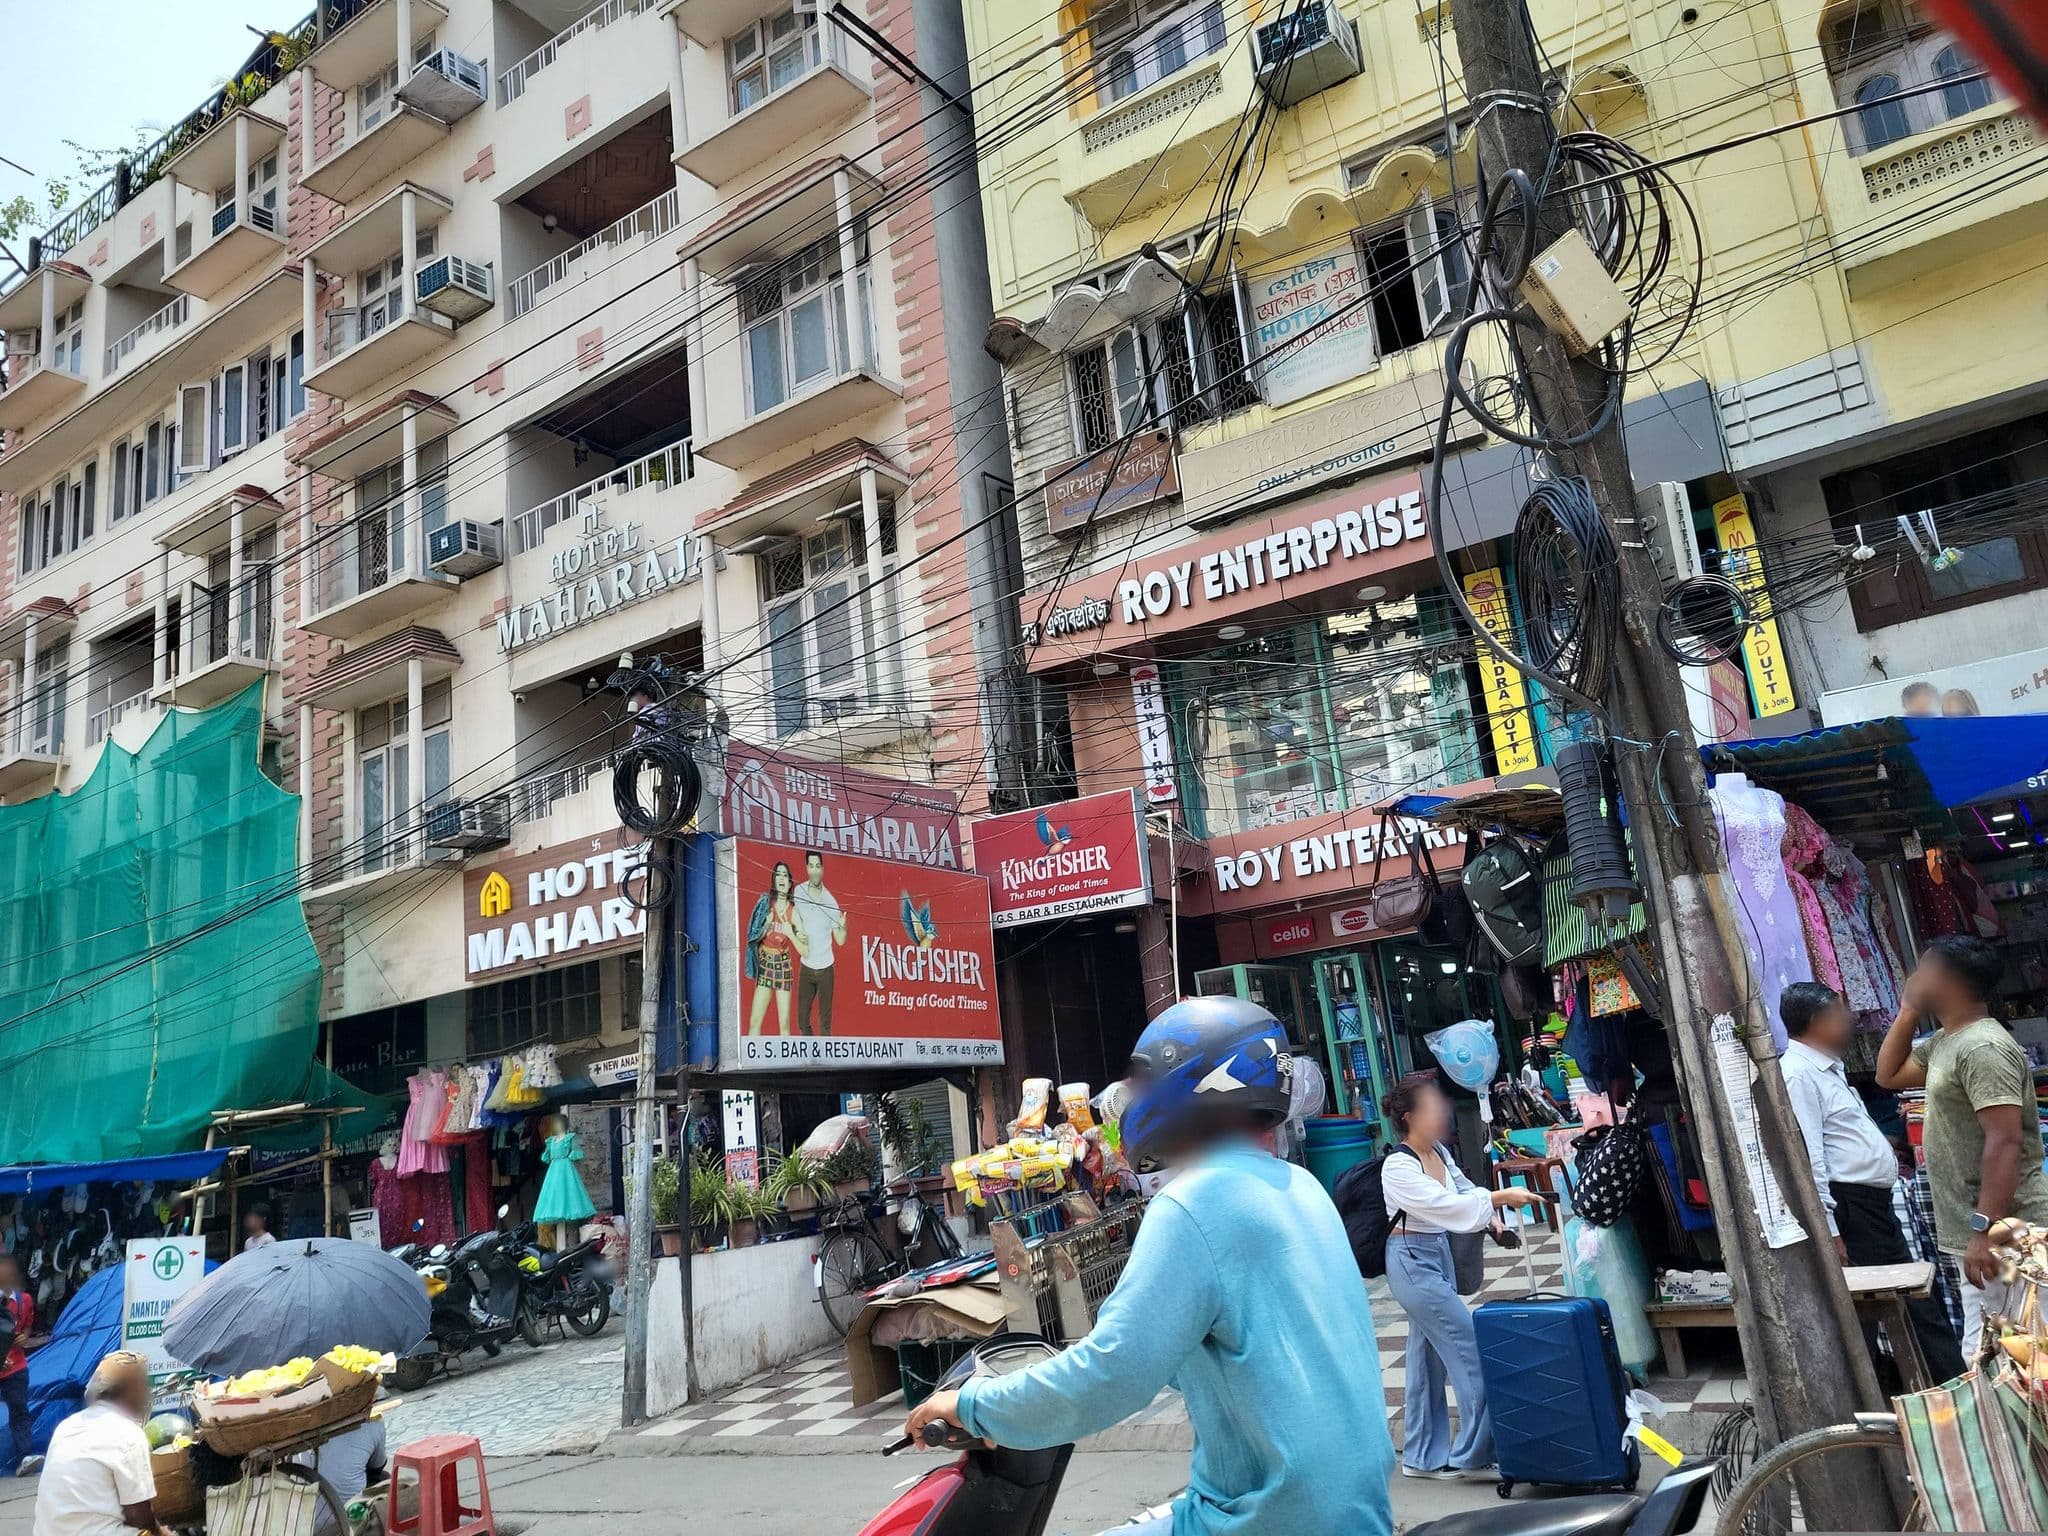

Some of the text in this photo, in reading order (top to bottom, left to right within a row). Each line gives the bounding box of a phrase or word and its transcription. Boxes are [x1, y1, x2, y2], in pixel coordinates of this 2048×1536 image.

[1261, 303, 1333, 342] HOTEL
[1310, 439, 1396, 477] LODGING
[550, 522, 643, 582] HOTEL
[1119, 560, 1193, 624] ROY
[1200, 490, 1427, 601] ENTERPRISE
[495, 534, 726, 650] MAHARAJA
[2010, 683, 2031, 700] EK
[784, 766, 837, 802] HOTEL
[787, 798, 958, 870] MAHARAJA
[1001, 845, 1112, 891] KINGFISHER
[1215, 845, 1285, 892] ROY
[1009, 876, 1109, 902] The King of Good Times
[1019, 908, 1041, 920] BAR
[1043, 906, 1051, 916] &
[1053, 894, 1125, 915] RESTAURANT
[1272, 925, 1311, 944] cello
[861, 934, 987, 992] KINGFISHER
[864, 990, 988, 1011] The King of Good Times
[603, 1059, 619, 1073] NEW
[747, 1041, 763, 1058] G.
[764, 1041, 777, 1058] S.
[781, 1041, 811, 1058] BAR
[812, 1041, 824, 1058] &
[825, 1041, 904, 1059] RESTAURANT
[130, 1300, 159, 1319] ANANTA
